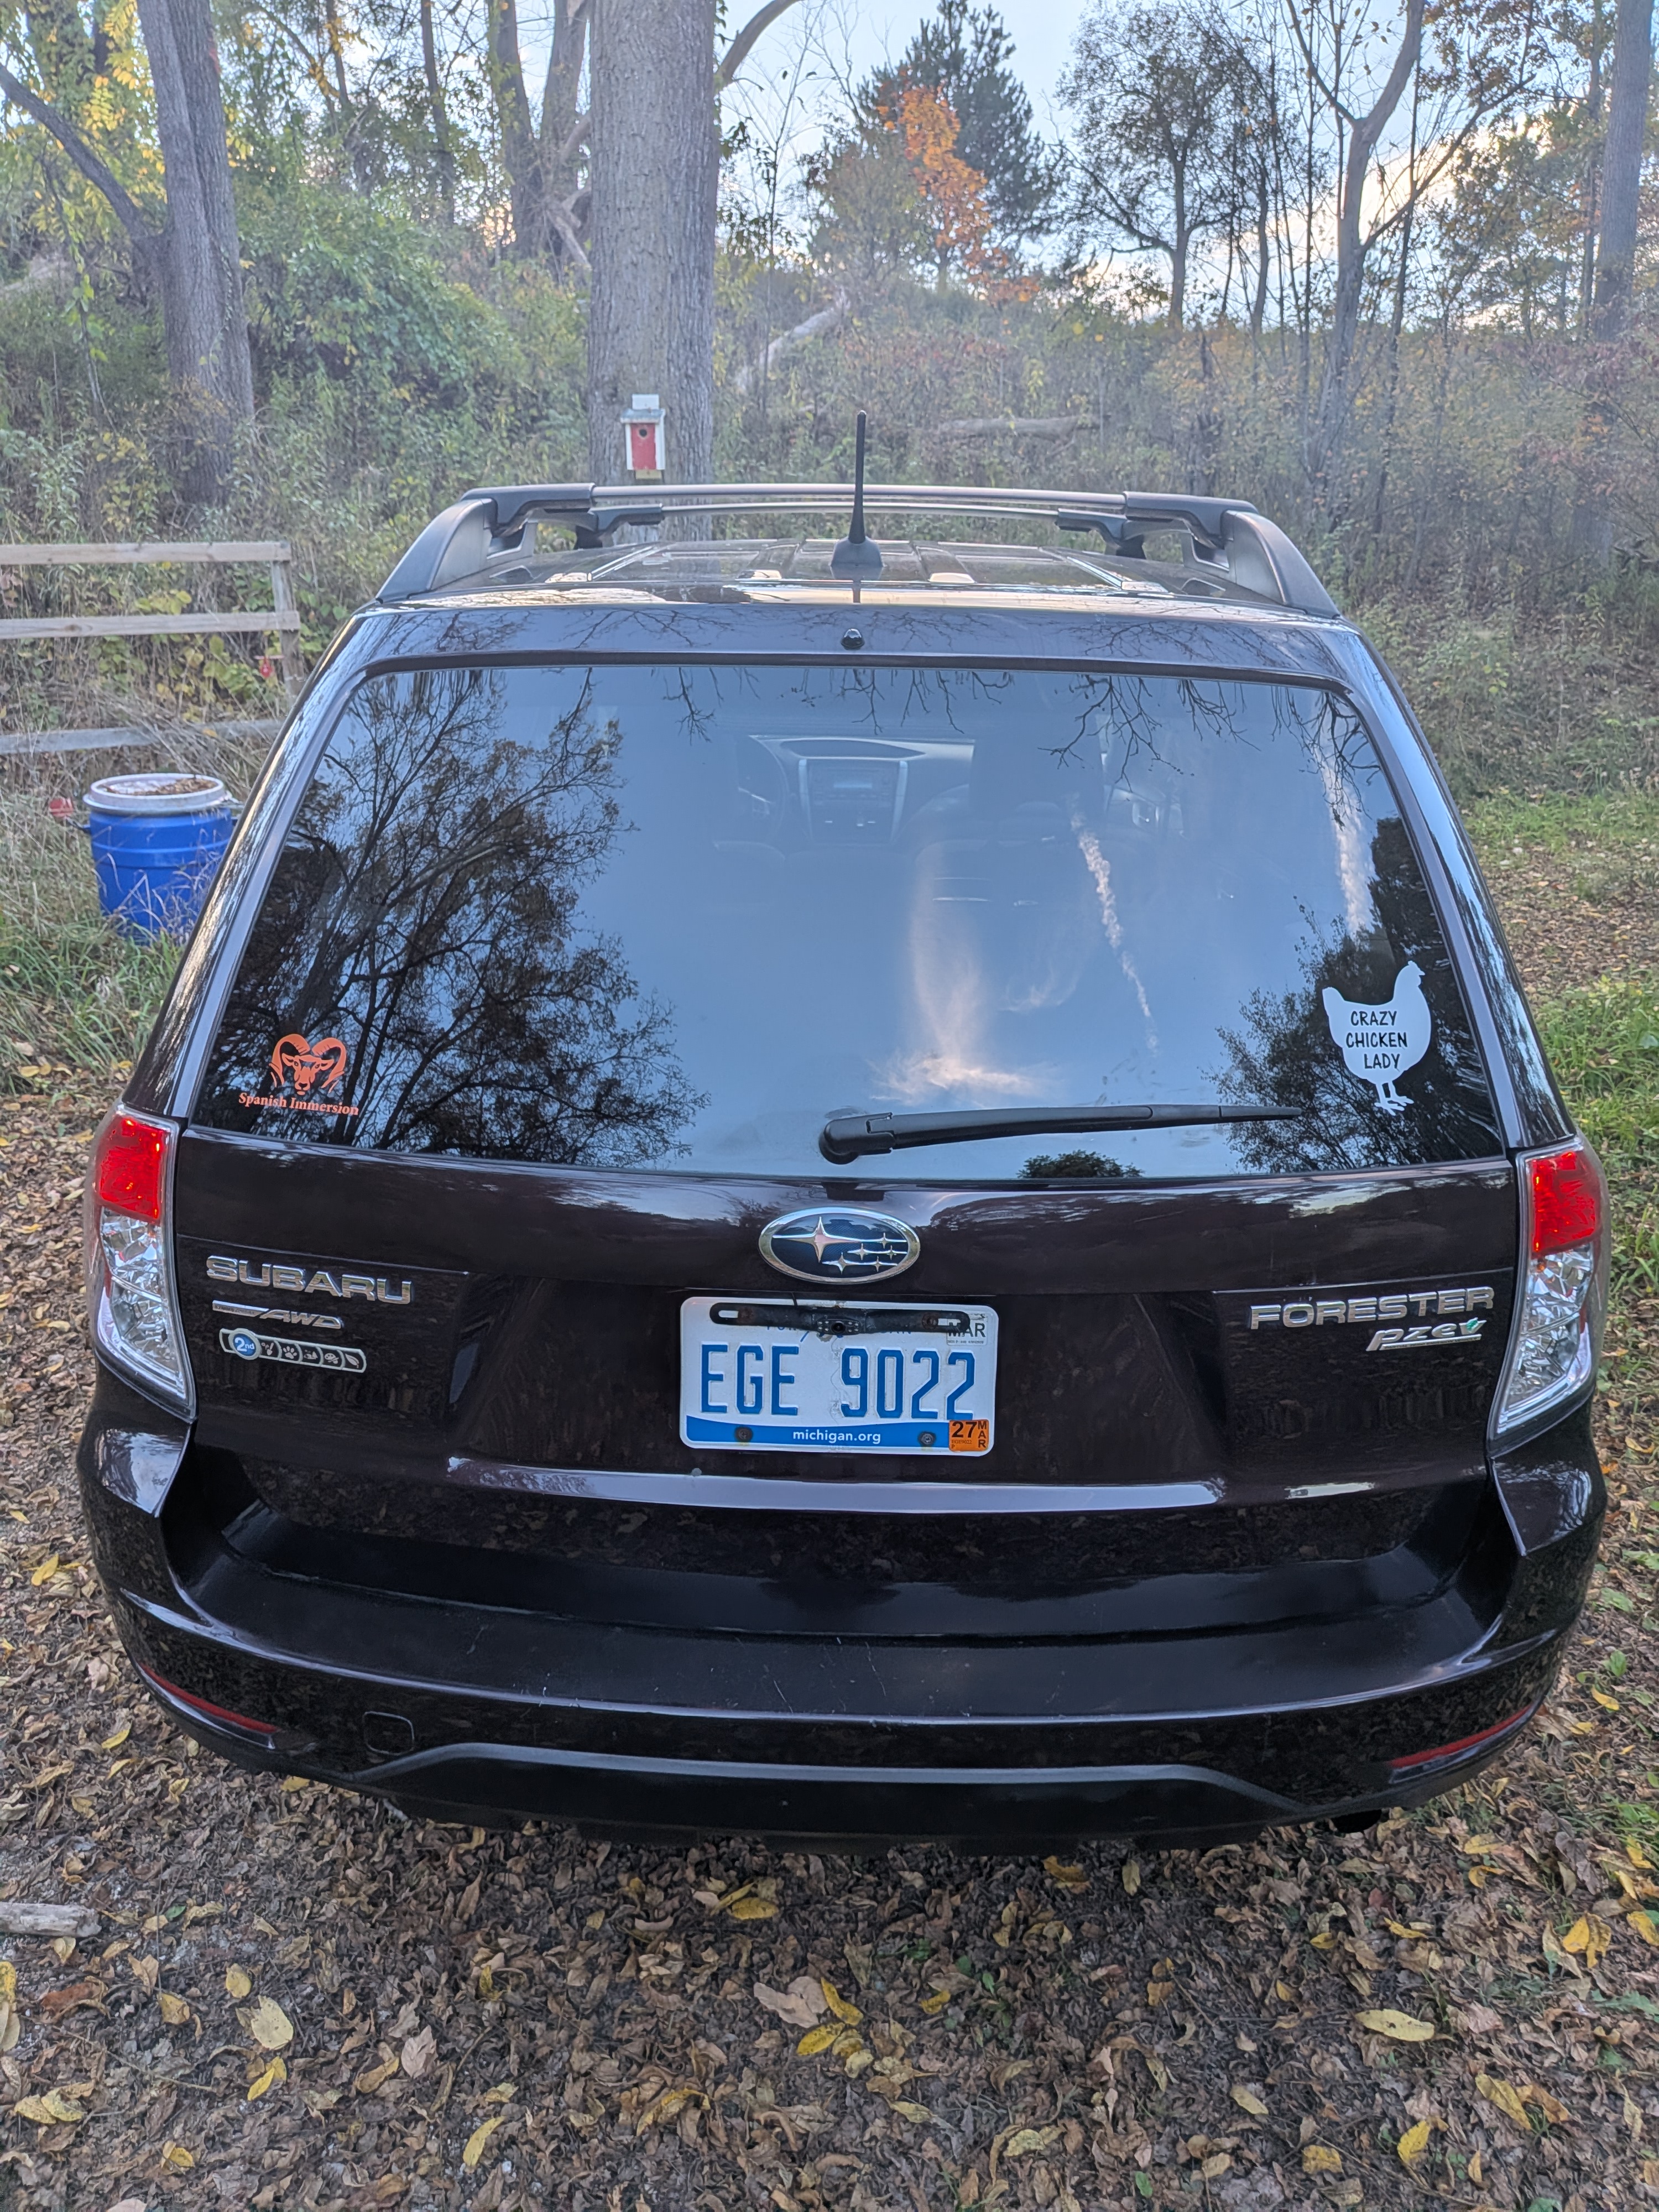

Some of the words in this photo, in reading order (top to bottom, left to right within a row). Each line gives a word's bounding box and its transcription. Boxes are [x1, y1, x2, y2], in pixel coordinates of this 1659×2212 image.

[1350, 1011, 1397, 1026] CRAZY
[1345, 1032, 1408, 1048] CHICKEN
[1364, 1053, 1401, 1070] LADY
[238, 1092, 287, 1108] Spanish
[289, 1097, 359, 1115] Immersion
[206, 1255, 412, 1304] SUBARU
[1249, 1286, 1495, 1329] FORESTER
[259, 1309, 344, 1329] AWD
[234, 1338, 255, 1352] 2nd
[701, 1344, 800, 1416] EGE
[841, 1348, 976, 1420] 9022
[792, 1430, 881, 1445] michigan.org
[952, 1421, 977, 1438] 27
[978, 1421, 986, 1448] MAR
